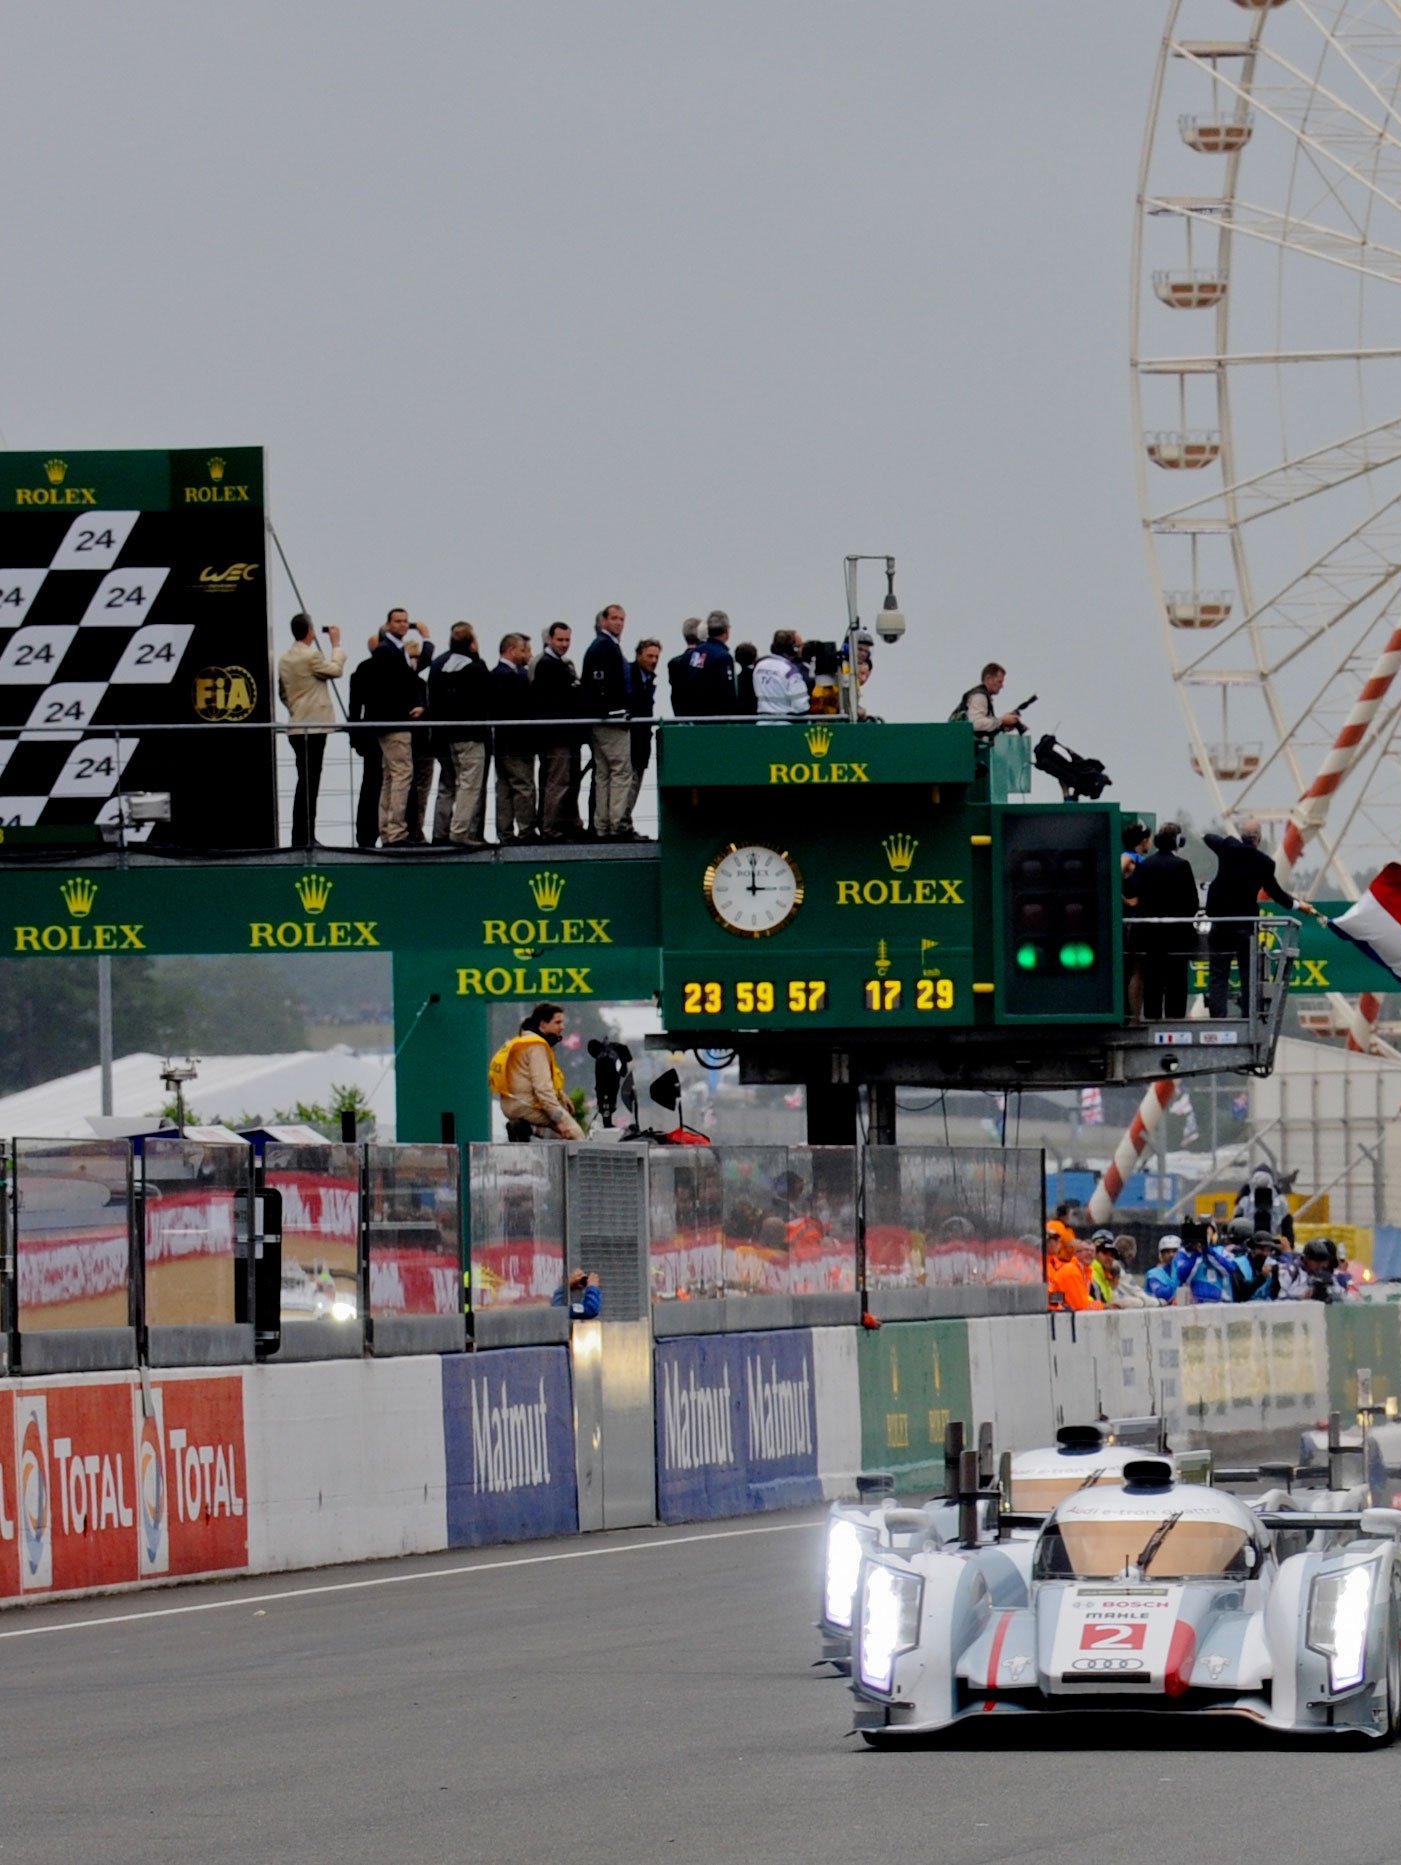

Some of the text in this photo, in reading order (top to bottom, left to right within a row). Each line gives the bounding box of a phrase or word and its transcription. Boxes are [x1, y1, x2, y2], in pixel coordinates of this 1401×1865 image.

[16, 488, 97, 505] ROLEX
[185, 485, 250, 502] ROLEX
[75, 529, 116, 552] 24
[199, 563, 260, 581] WEC
[0, 587, 25, 607] 4
[105, 585, 147, 609] 24
[13, 643, 55, 666] 24
[134, 642, 176, 665] 24
[43, 700, 85, 724] 24
[74, 755, 115, 780] 24
[769, 763, 870, 784] ROLEX
[836, 880, 965, 905] ROLEX
[15, 925, 146, 951] ROLEX
[249, 921, 380, 948] ROLEX
[483, 919, 612, 945] ROLEX
[456, 967, 594, 996] ROLEX
[916, 978, 954, 1010] 29
[684, 980, 826, 1014] 23 59 57
[865, 980, 902, 1011] 17
[663, 1355, 812, 1472] Matmut Matmut
[471, 1376, 551, 1495] Matmut
[53, 1437, 133, 1536] TOTAL
[169, 1428, 244, 1524] TOTAL
[1066, 1505, 1221, 1517] Audi e-tron quattro
[1090, 1624, 1134, 1650] 2
